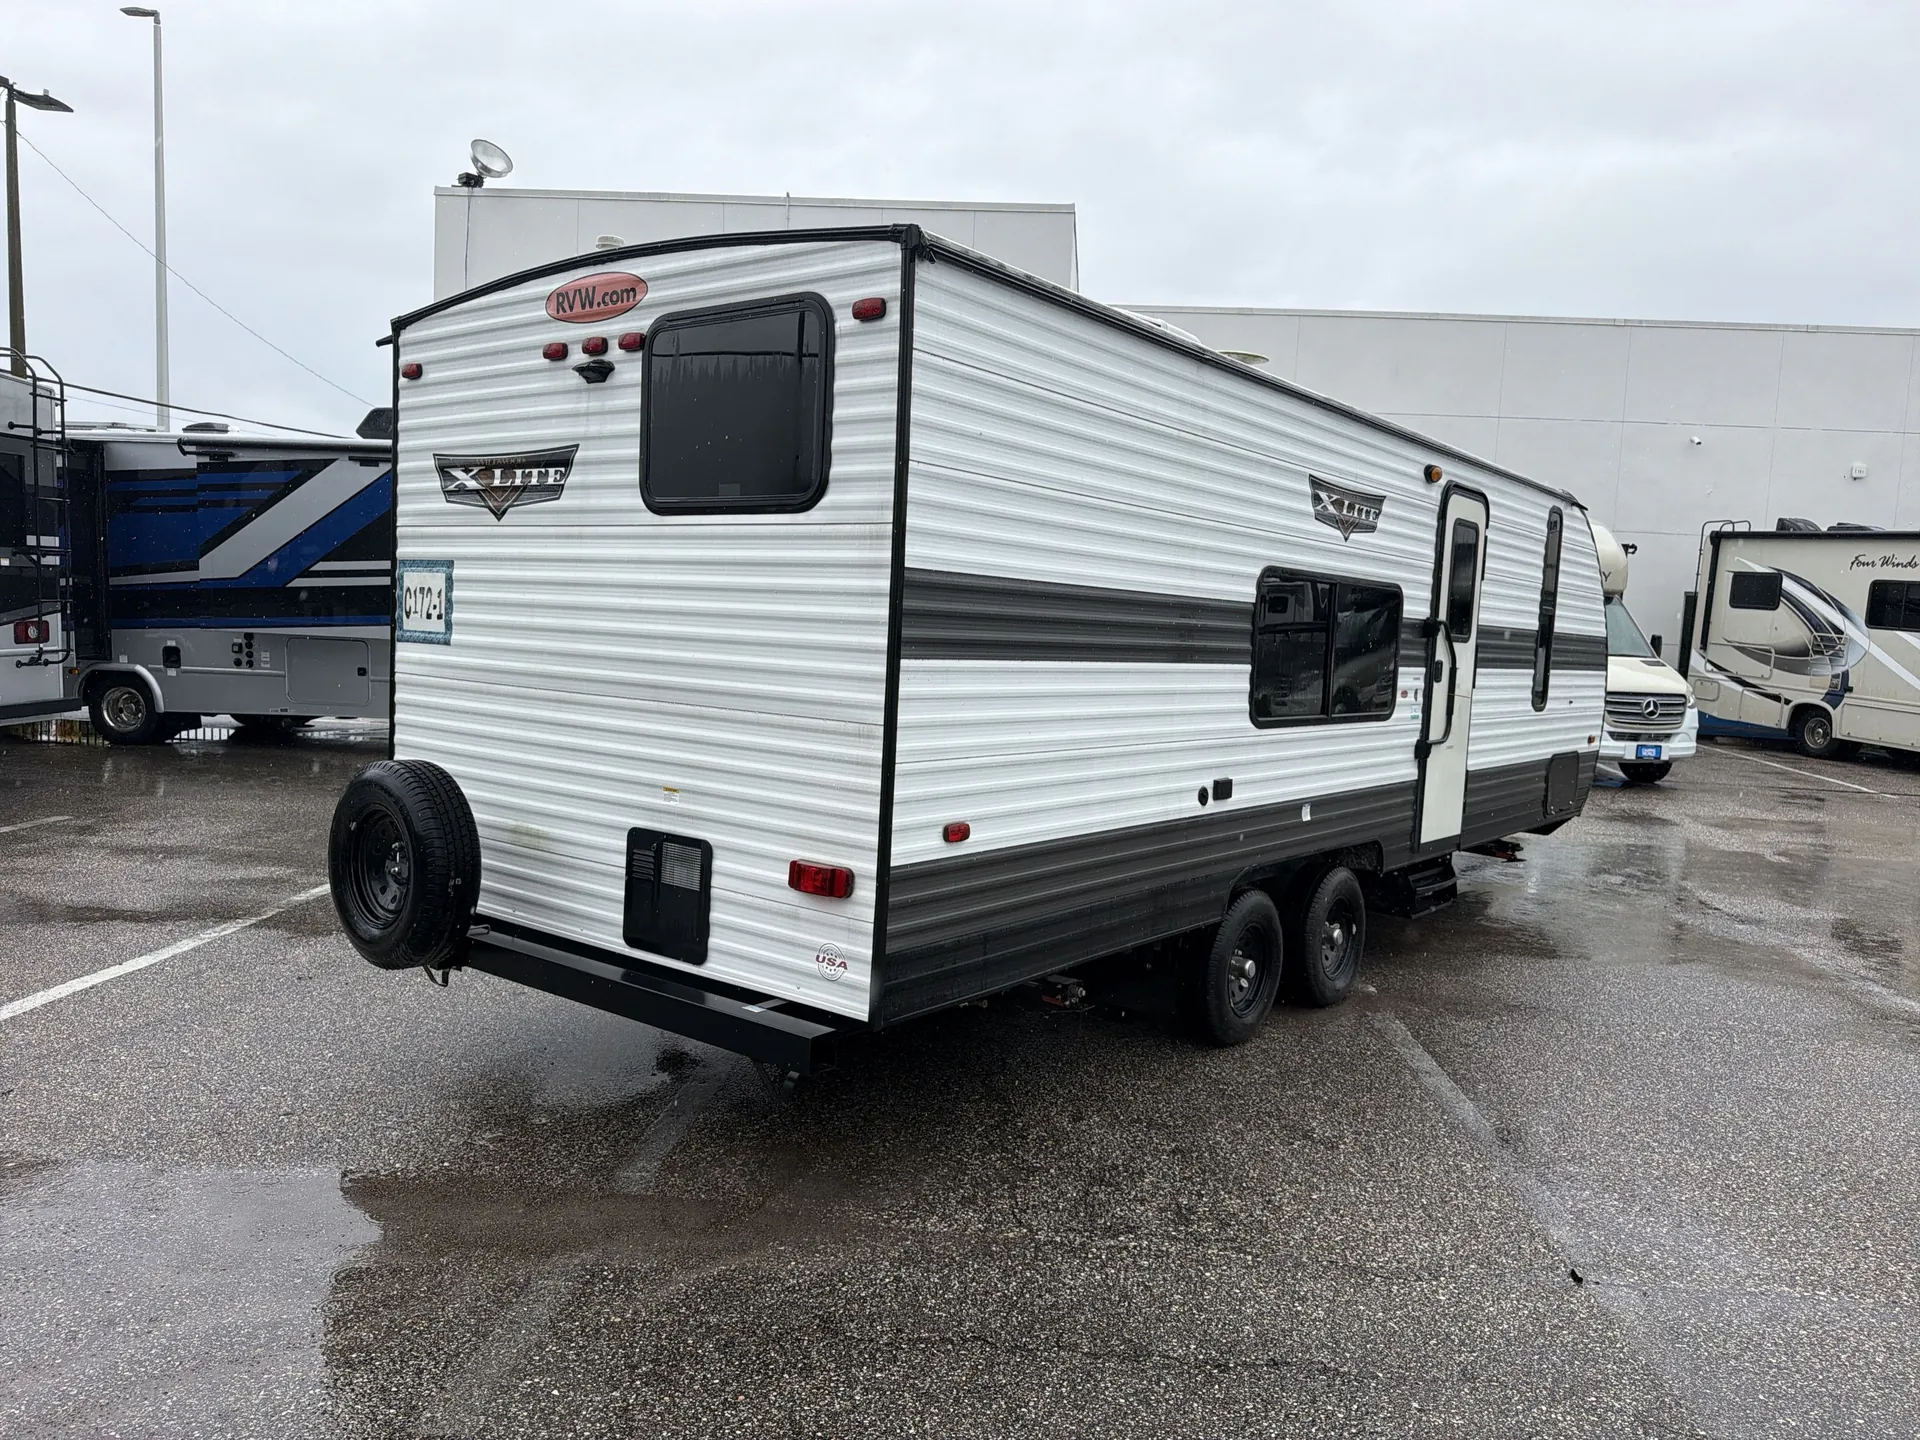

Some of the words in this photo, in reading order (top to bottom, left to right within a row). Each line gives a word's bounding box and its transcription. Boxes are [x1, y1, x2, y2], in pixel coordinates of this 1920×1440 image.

[556, 286, 637, 314] RVW.com
[443, 466, 486, 491] X
[490, 467, 566, 487] LITE
[1314, 489, 1341, 516] X
[1341, 499, 1379, 522] LITE
[1850, 553, 1877, 571] Four
[1878, 553, 1919, 569] Winds
[404, 586, 443, 620] C172-1
[815, 954, 848, 970] USA
